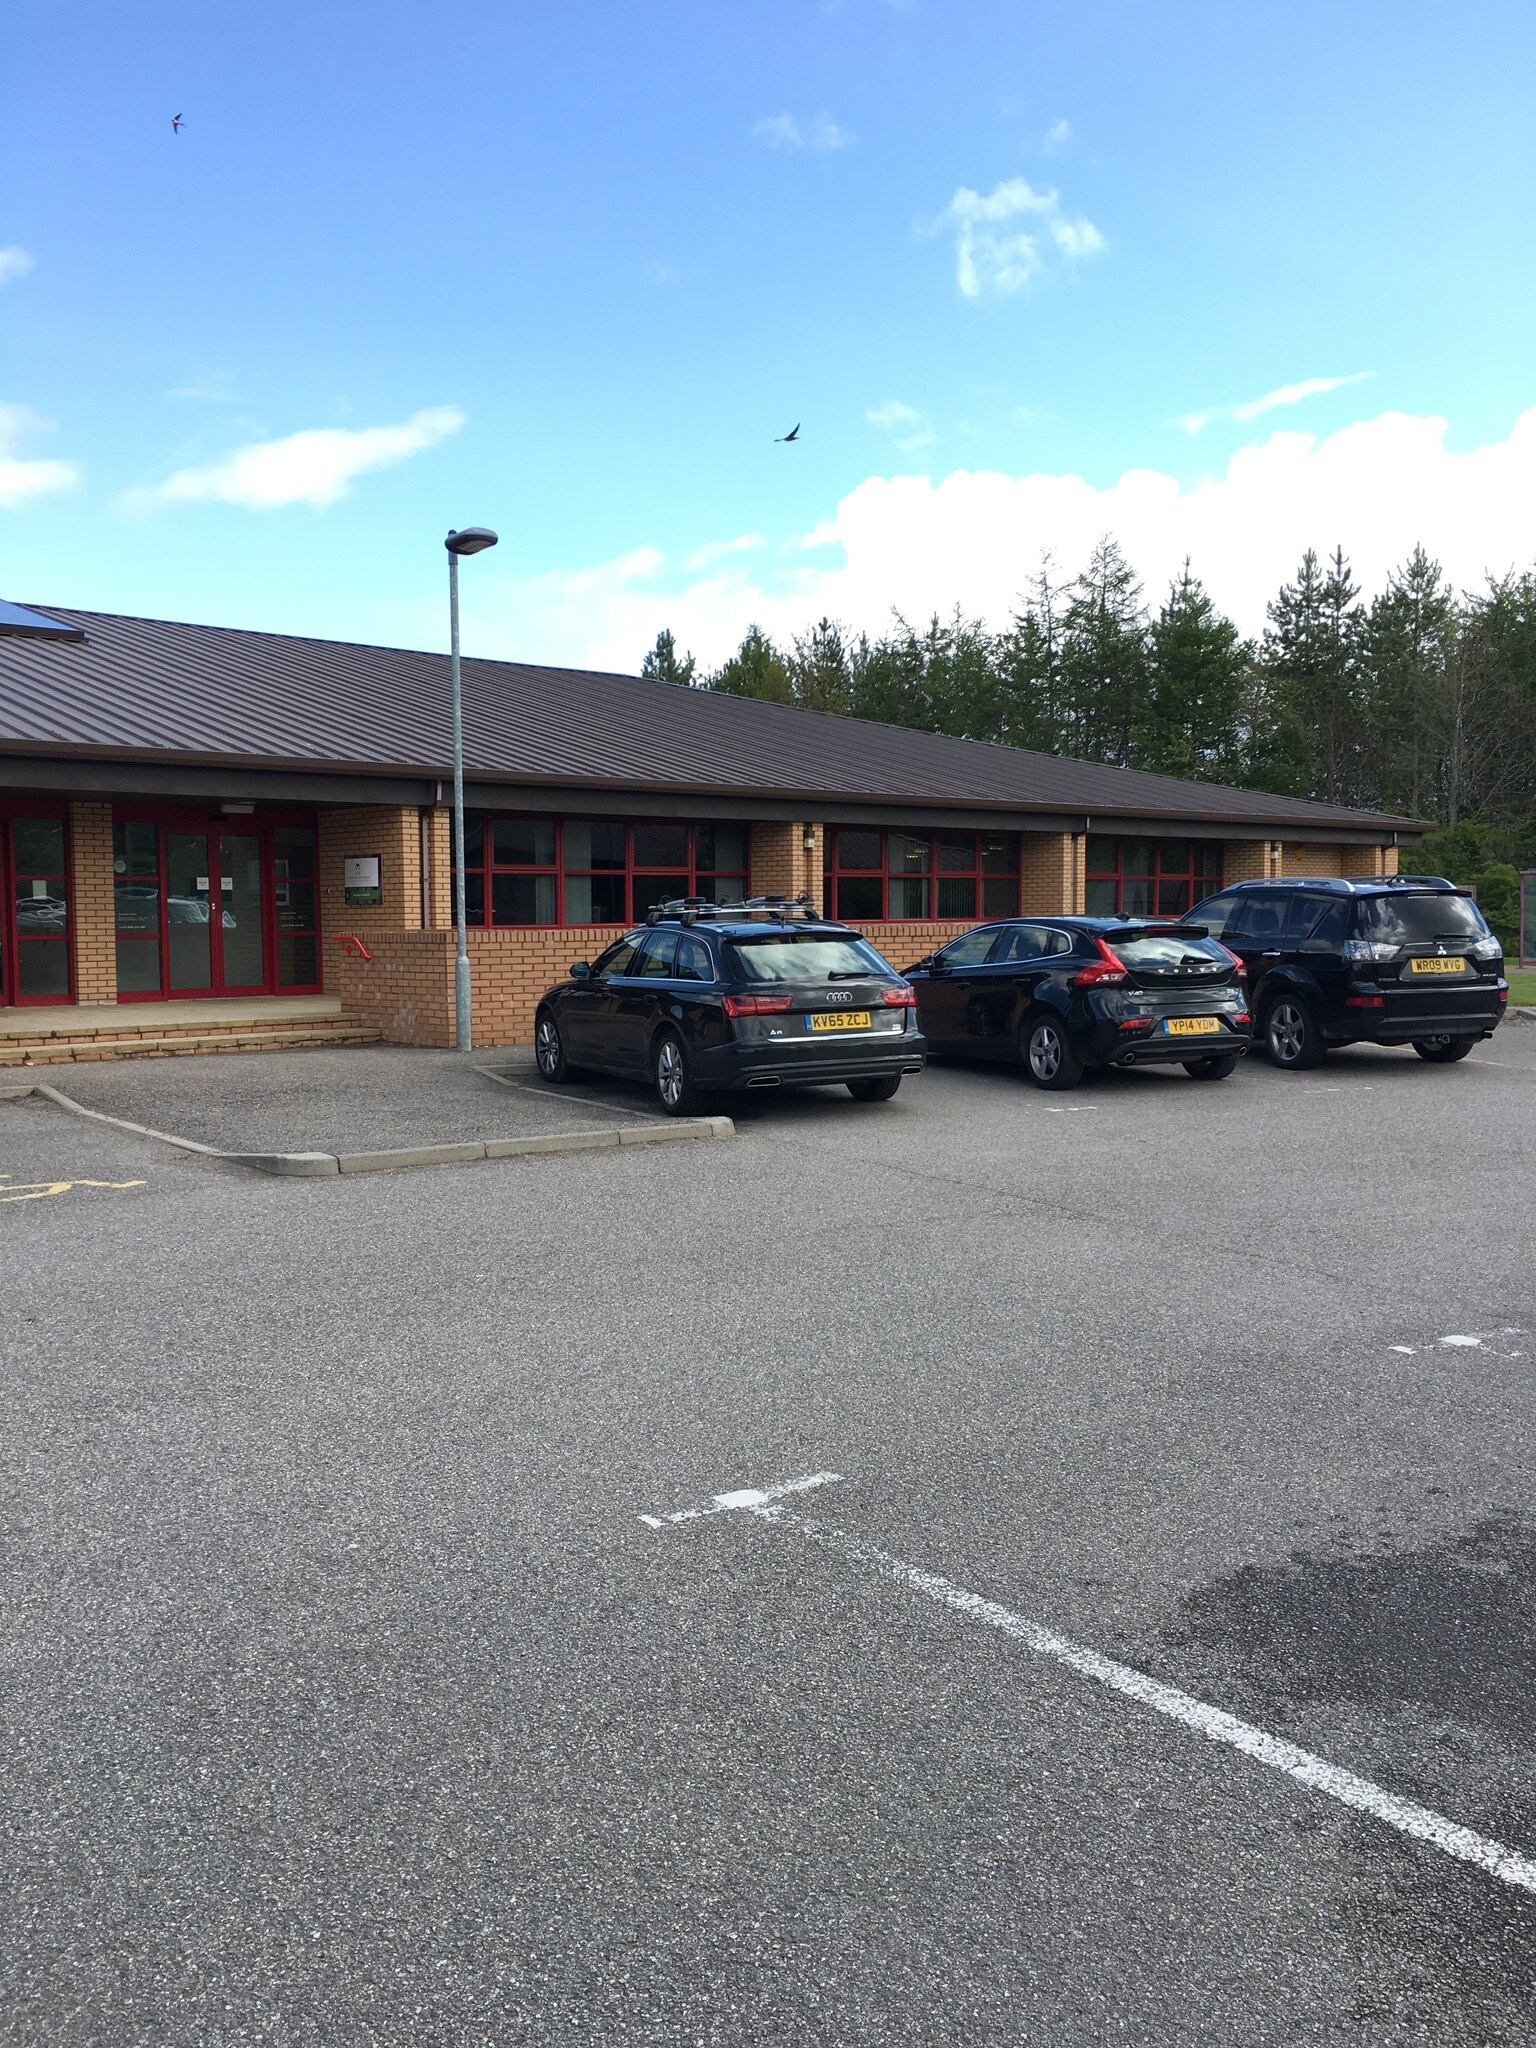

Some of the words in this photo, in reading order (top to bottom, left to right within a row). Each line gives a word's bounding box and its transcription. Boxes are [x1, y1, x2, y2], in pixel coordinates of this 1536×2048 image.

[813, 1014, 844, 1029] KV65
[846, 1013, 869, 1027] ZCJ
[1173, 1019, 1194, 1032] YP14
